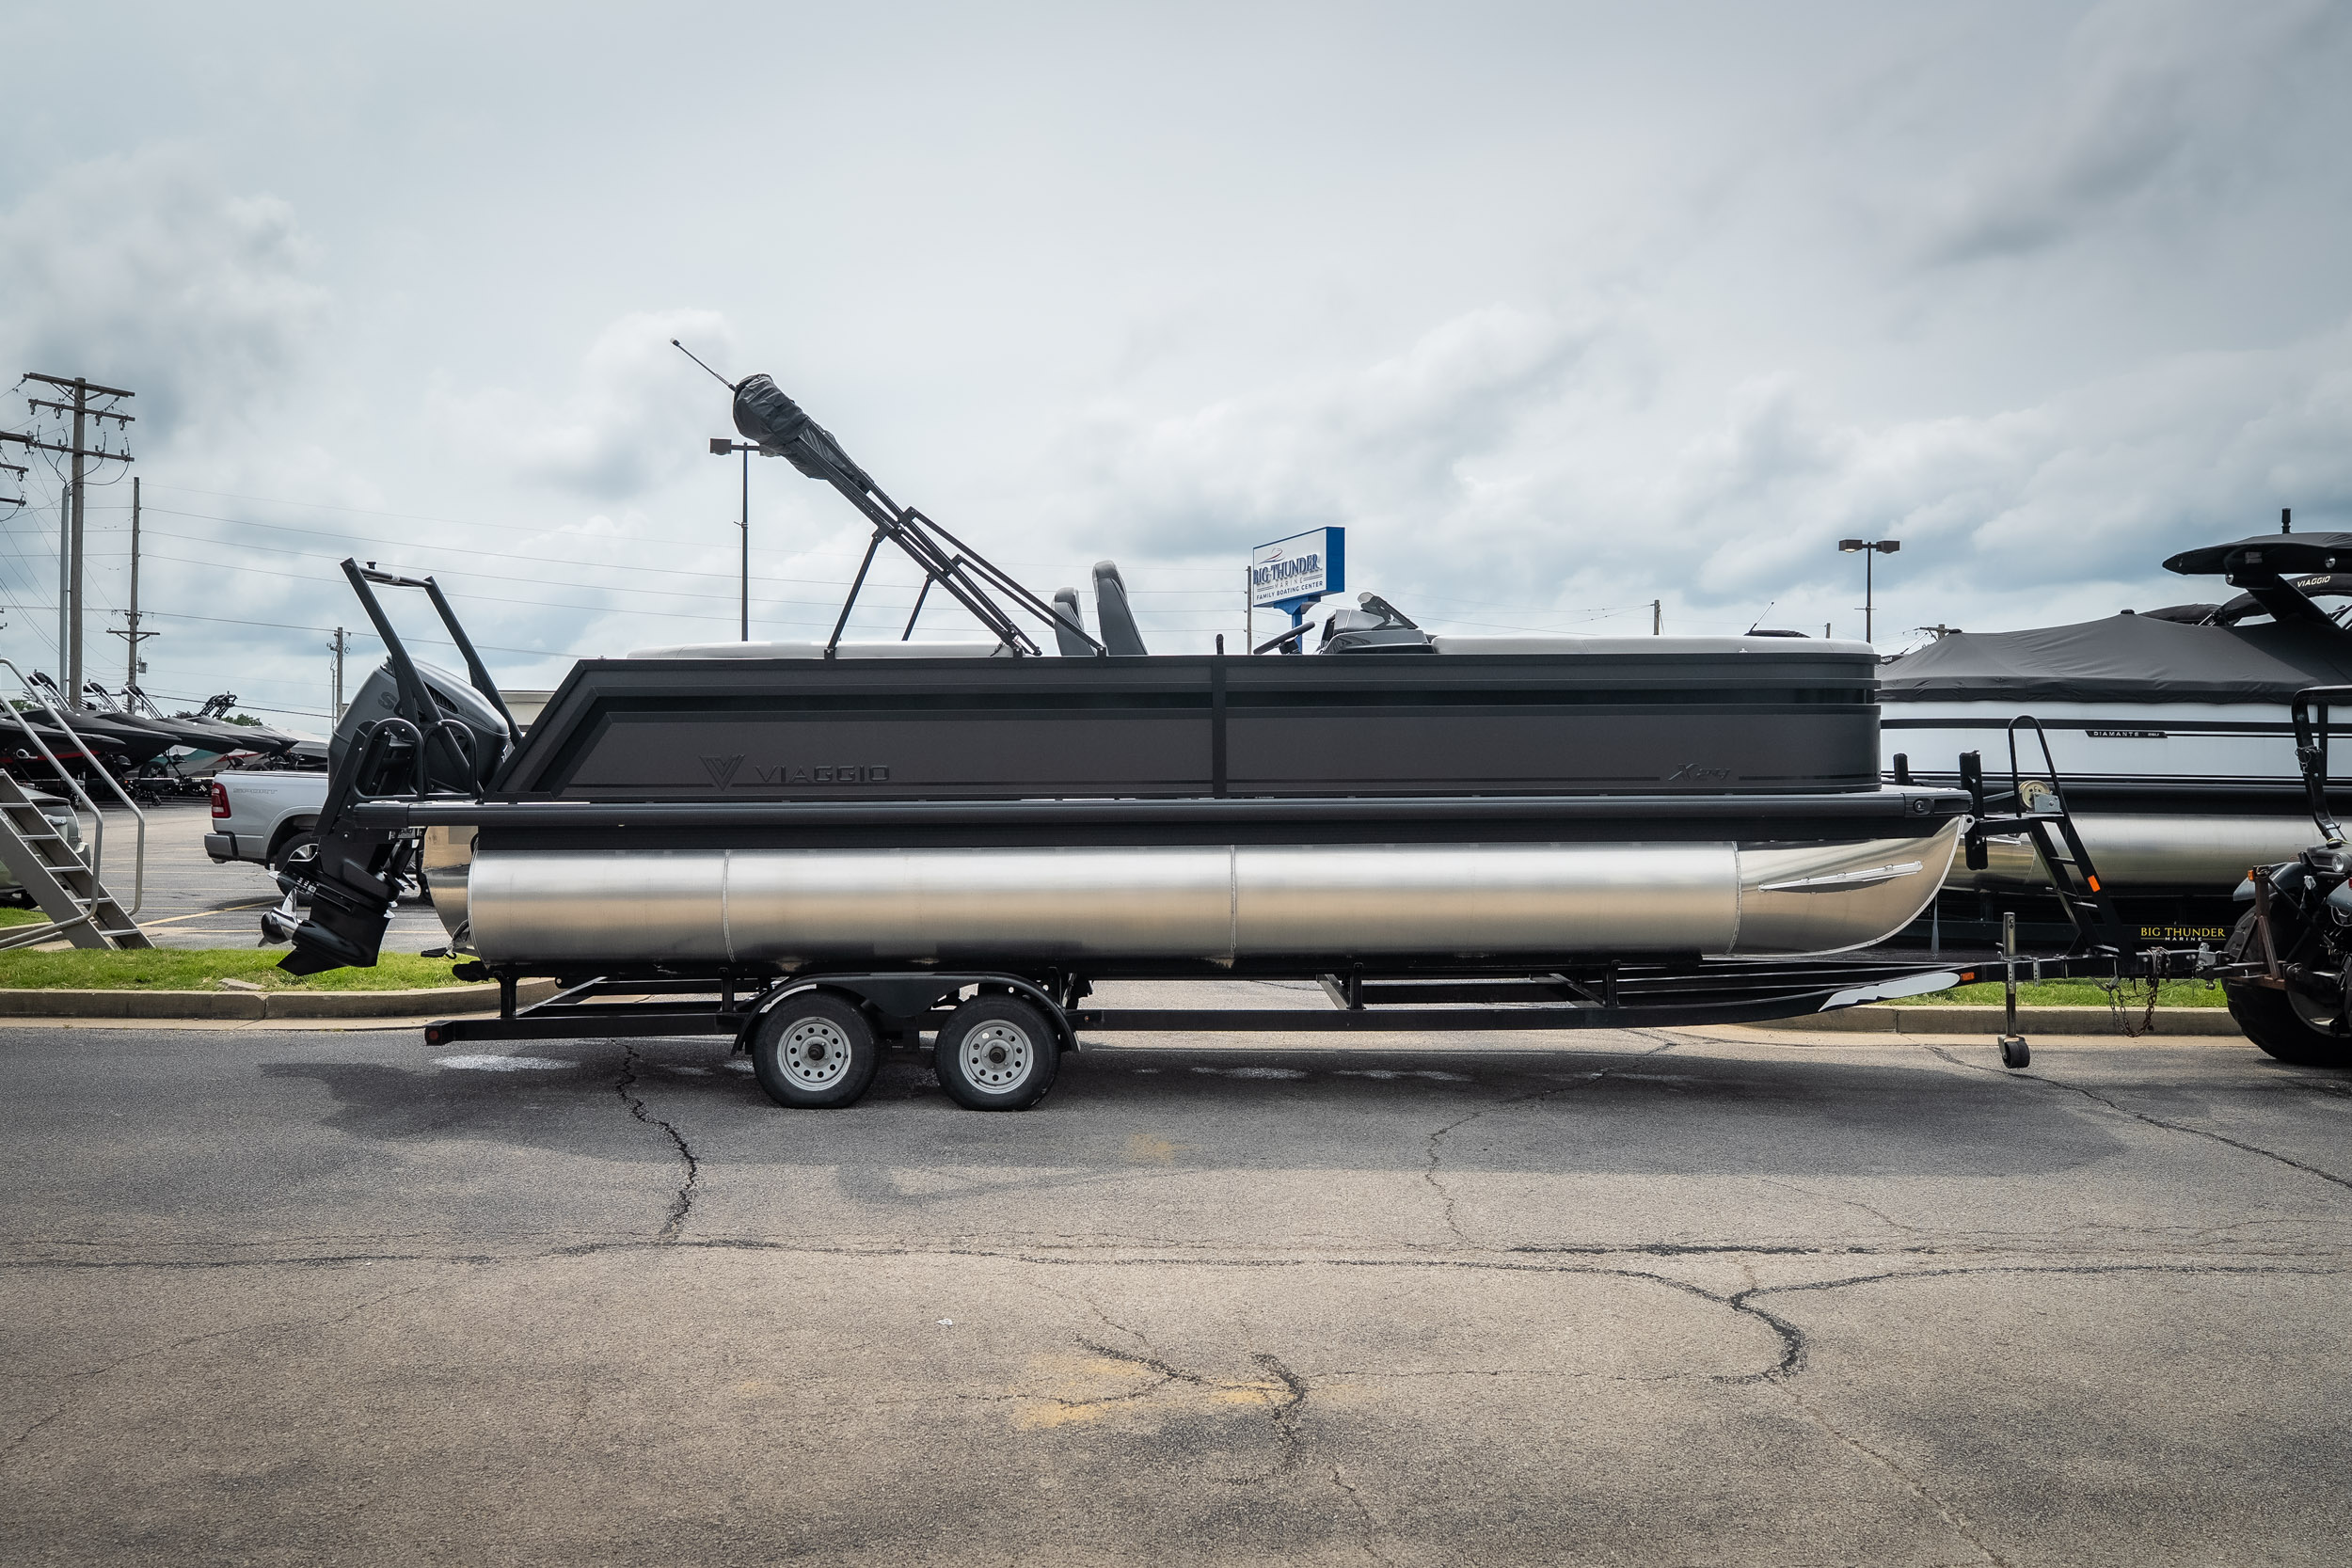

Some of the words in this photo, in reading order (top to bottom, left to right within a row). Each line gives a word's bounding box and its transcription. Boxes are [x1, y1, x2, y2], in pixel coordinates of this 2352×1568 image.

[1253, 566, 1270, 584] BIG
[1270, 553, 1320, 579] THUNDER
[1274, 577, 1304, 590] MARINE
[2296, 575, 2331, 588] VIAGGIO
[1256, 592, 1275, 600] FAMILY
[1277, 585, 1300, 596] BOATING
[1301, 580, 1324, 591] CENTER
[755, 765, 890, 783] VIAGGIO
[2140, 927, 2161, 937] BIG
[2165, 927, 2226, 937] THUNDER
